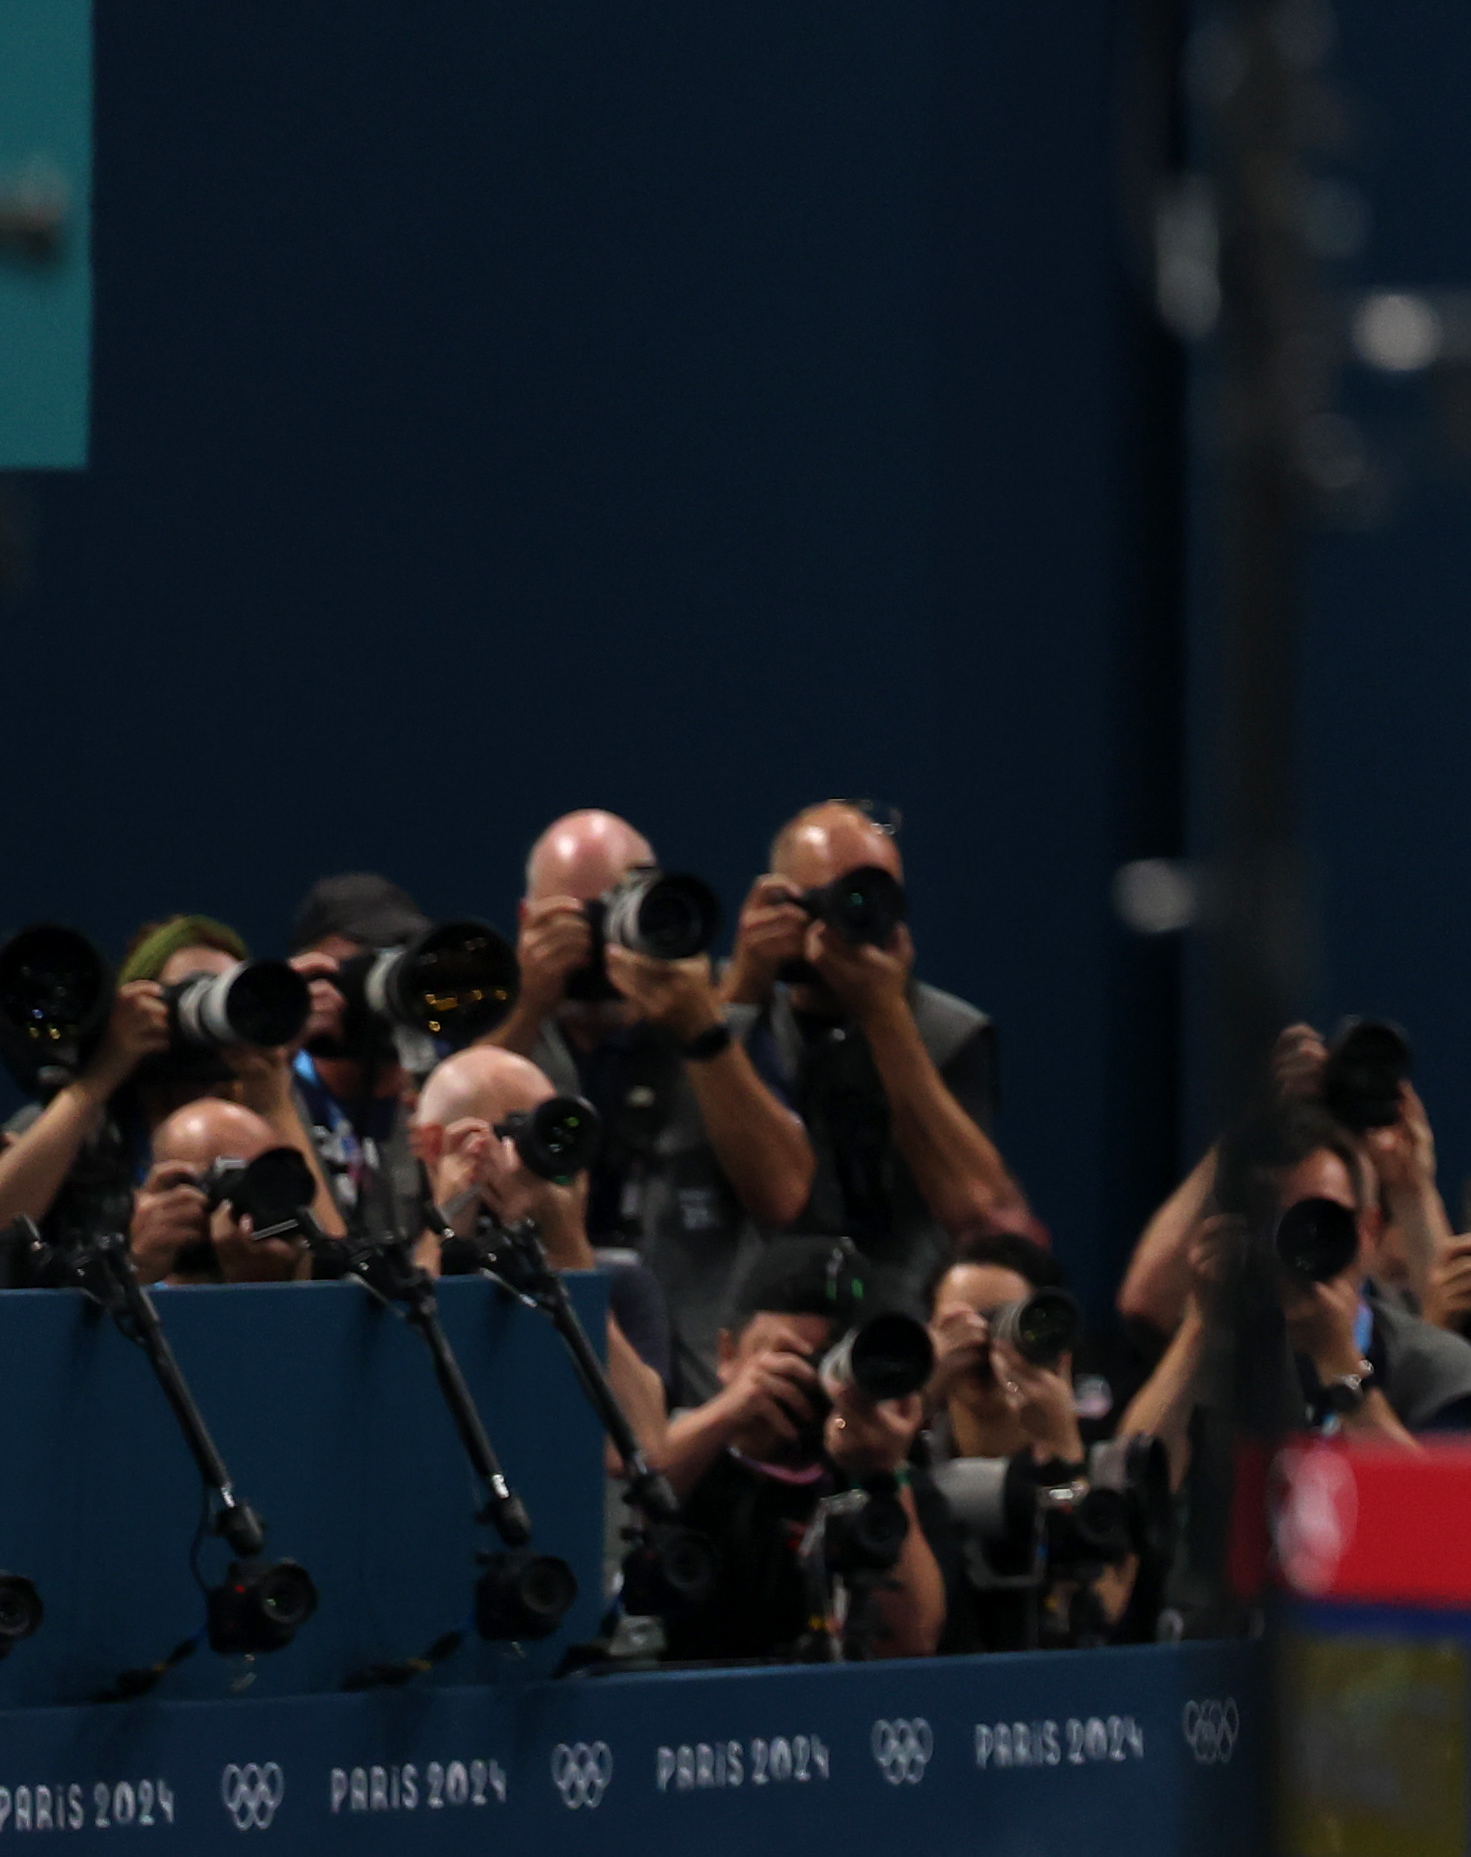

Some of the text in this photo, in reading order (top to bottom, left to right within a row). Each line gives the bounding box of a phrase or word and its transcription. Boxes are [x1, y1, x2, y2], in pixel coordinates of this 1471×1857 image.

[427, 1757, 508, 1810] 2024
[751, 1734, 831, 1786] 2024
[94, 1779, 175, 1830] 2024
